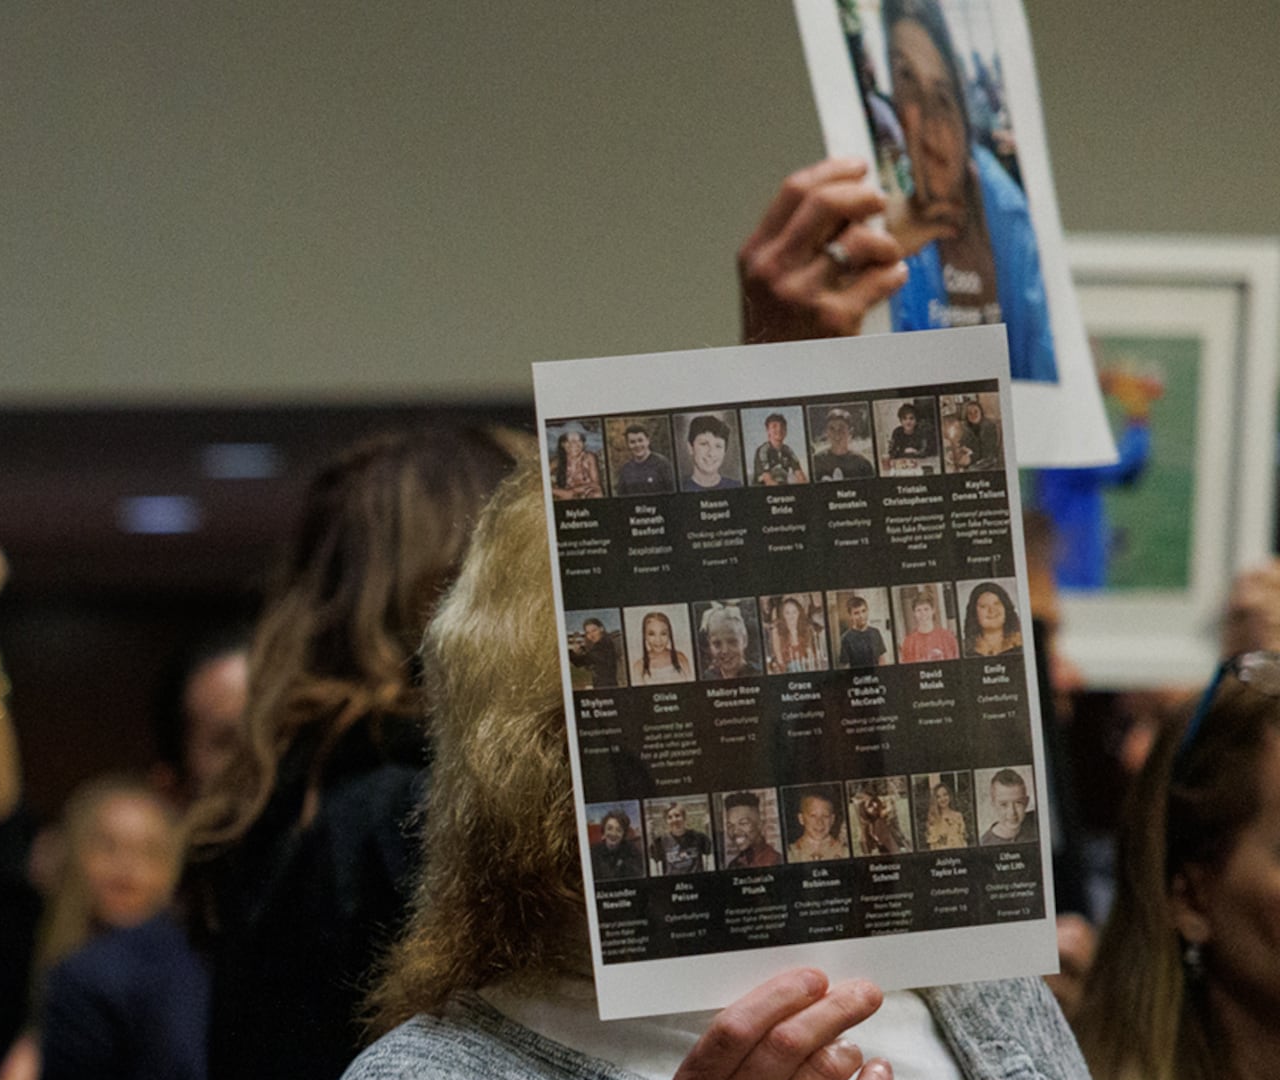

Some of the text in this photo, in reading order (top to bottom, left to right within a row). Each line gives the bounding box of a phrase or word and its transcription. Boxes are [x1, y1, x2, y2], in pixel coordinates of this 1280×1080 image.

[837, 489, 857, 498] Nate
[700, 500, 729, 508] Mason
[766, 495, 795, 504] Carson
[635, 505, 657, 514] Riley
[771, 505, 793, 515] Bride
[919, 669, 943, 679] David
[788, 681, 812, 690] Grace
[653, 704, 680, 713] Green
